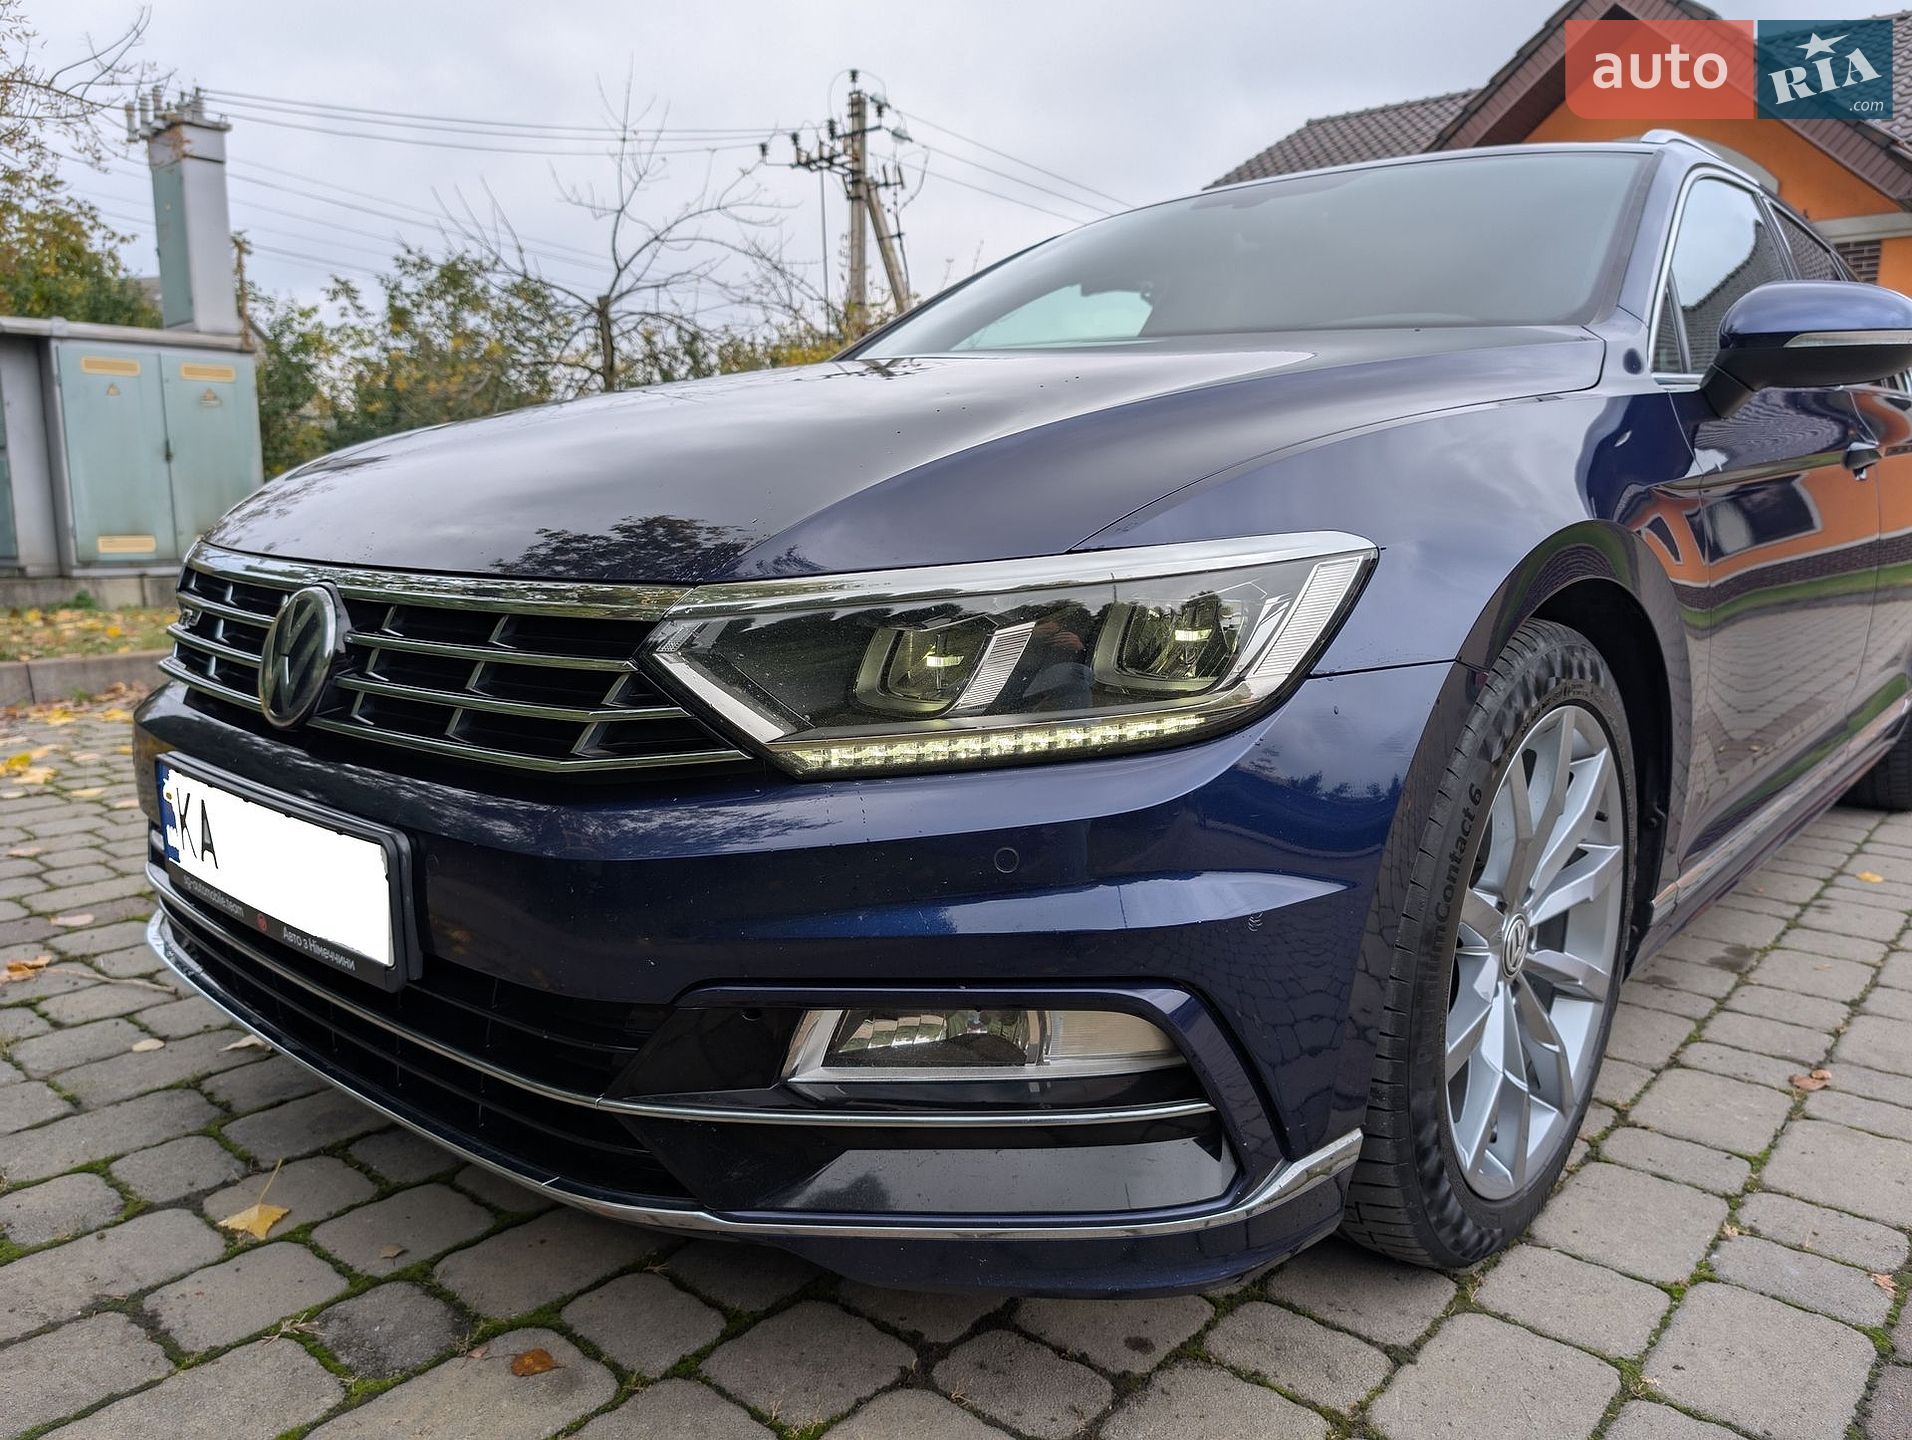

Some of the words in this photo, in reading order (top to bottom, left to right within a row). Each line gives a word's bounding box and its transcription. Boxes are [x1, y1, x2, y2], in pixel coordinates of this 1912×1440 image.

[1468, 782, 1482, 806] 6
[175, 787, 218, 870] KA
[283, 926, 303, 946] Авто
